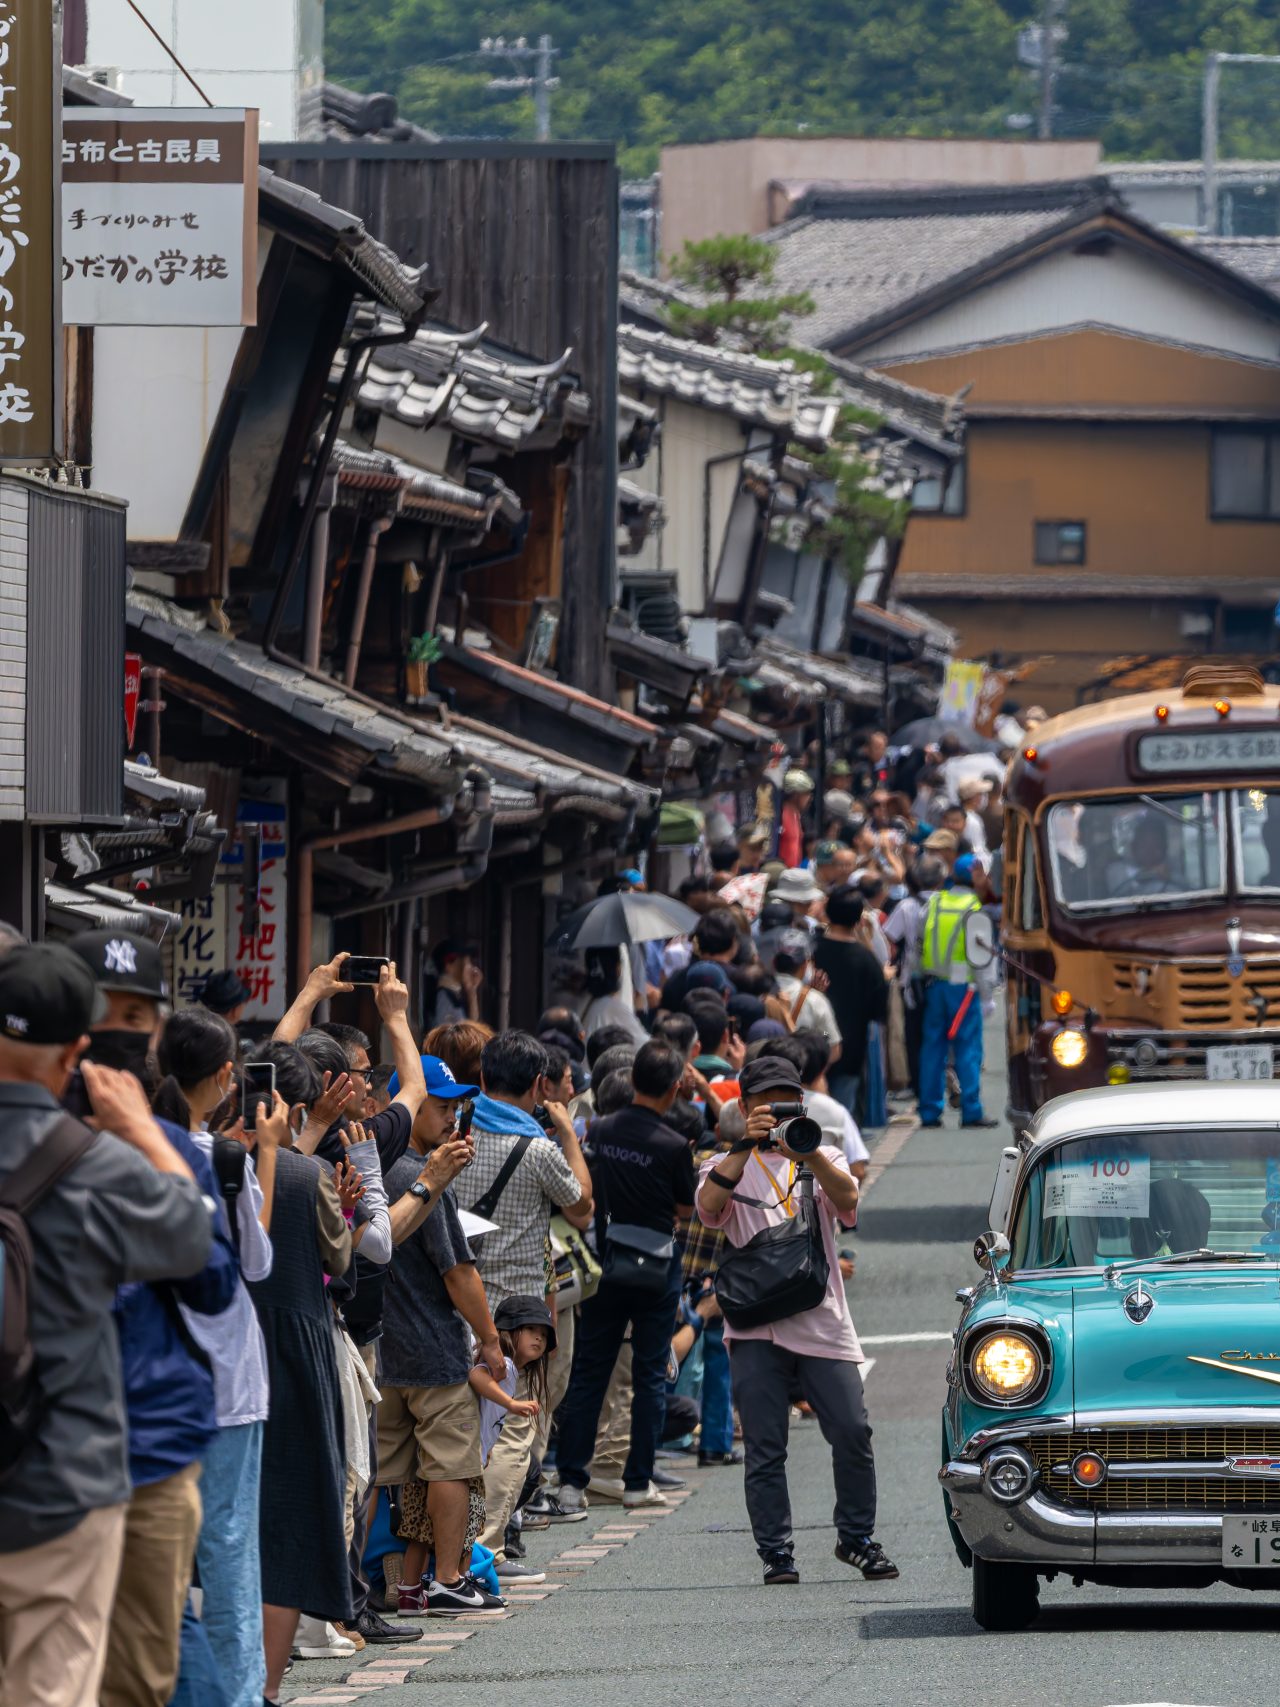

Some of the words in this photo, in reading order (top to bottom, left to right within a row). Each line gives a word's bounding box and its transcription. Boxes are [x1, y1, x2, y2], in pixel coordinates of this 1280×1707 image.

[62, 139, 221, 163] 古布と古民具
[68, 208, 199, 230] 手づくりのみせ
[104, 938, 137, 973] NY
[1090, 1159, 1131, 1178] 100
[1231, 1544, 1243, 1558] な
